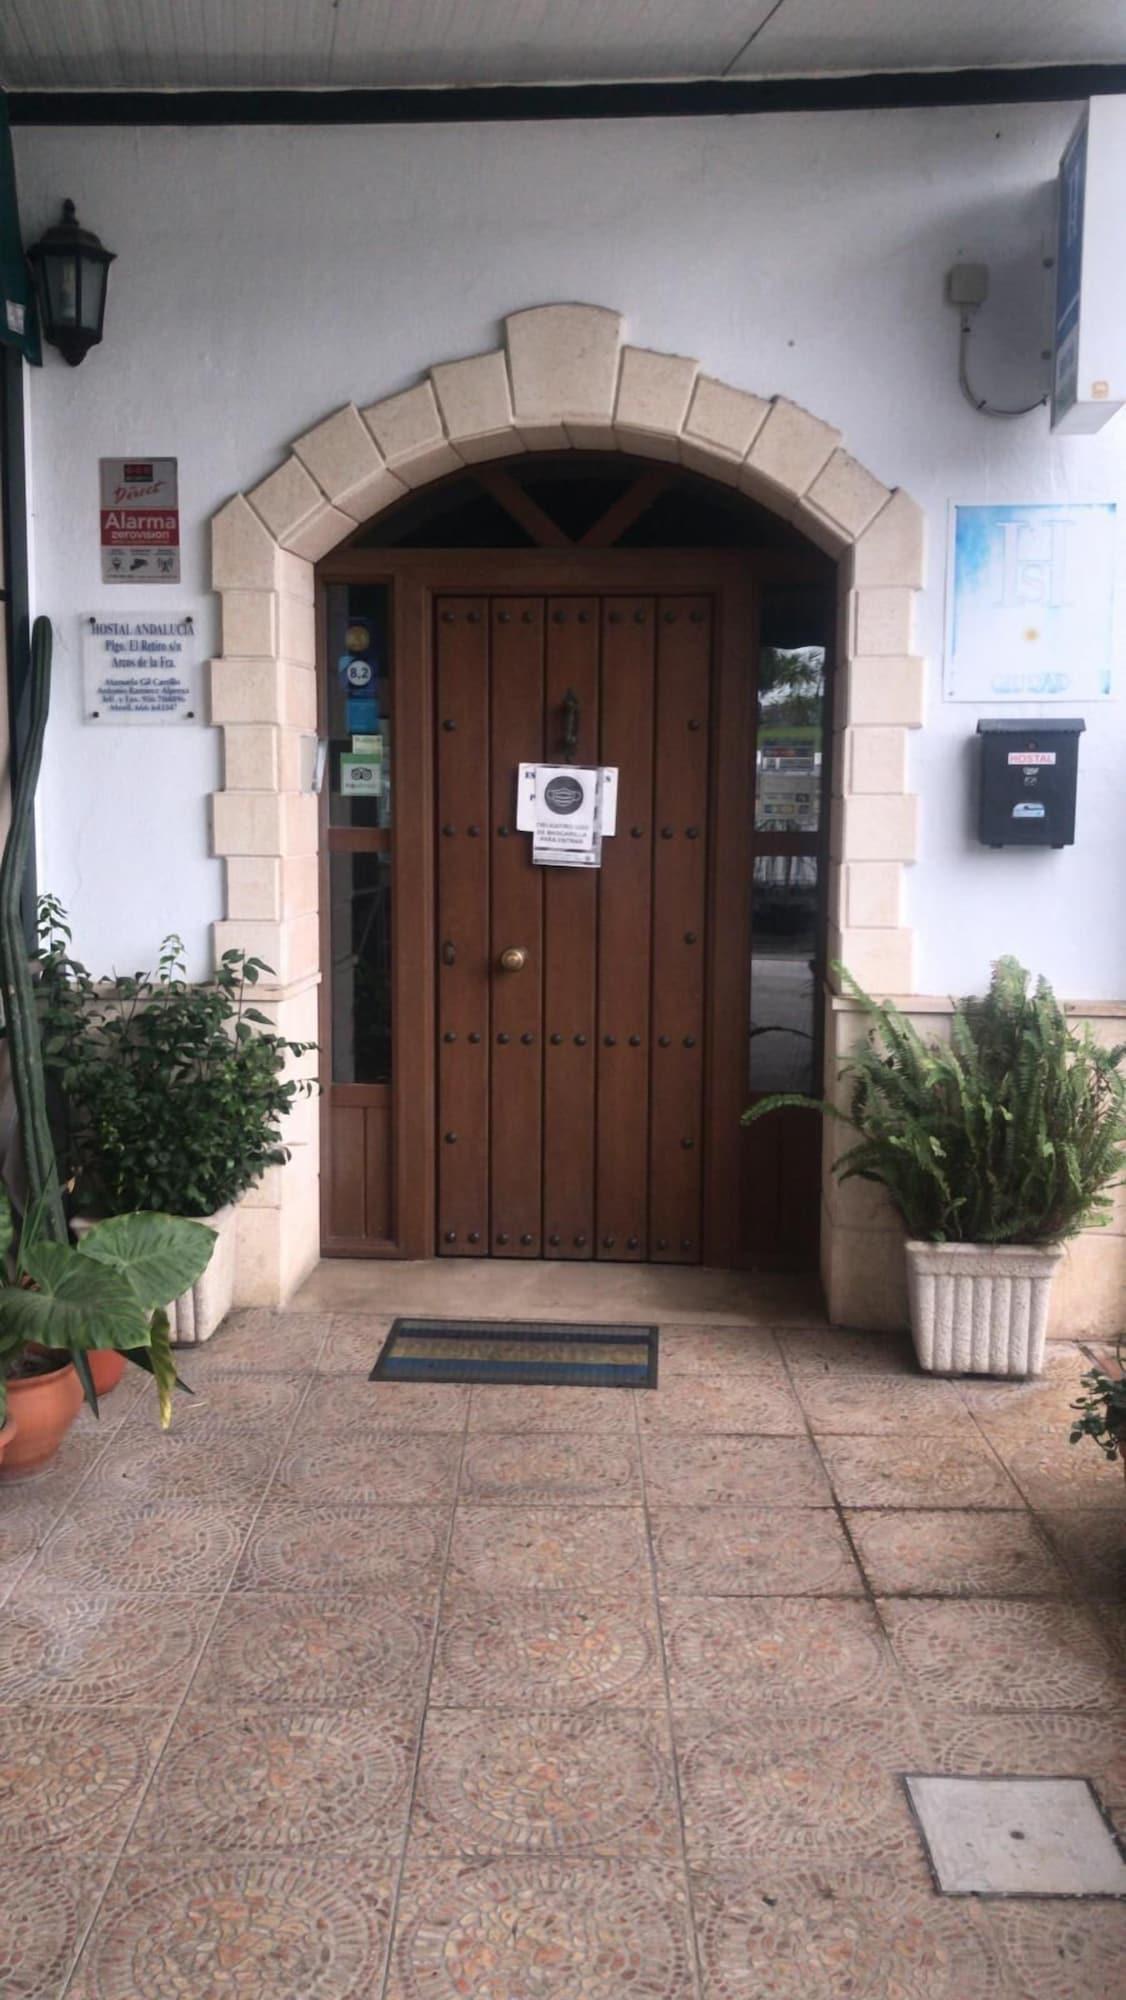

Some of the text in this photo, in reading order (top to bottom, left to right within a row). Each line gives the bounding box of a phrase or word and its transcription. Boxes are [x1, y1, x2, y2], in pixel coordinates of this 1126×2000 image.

[104, 512, 177, 529] Alarma
[92, 623, 131, 636] HOSTAL
[137, 656, 147, 668] de
[149, 656, 158, 668] la
[1011, 754, 1053, 763] HOSTAL
